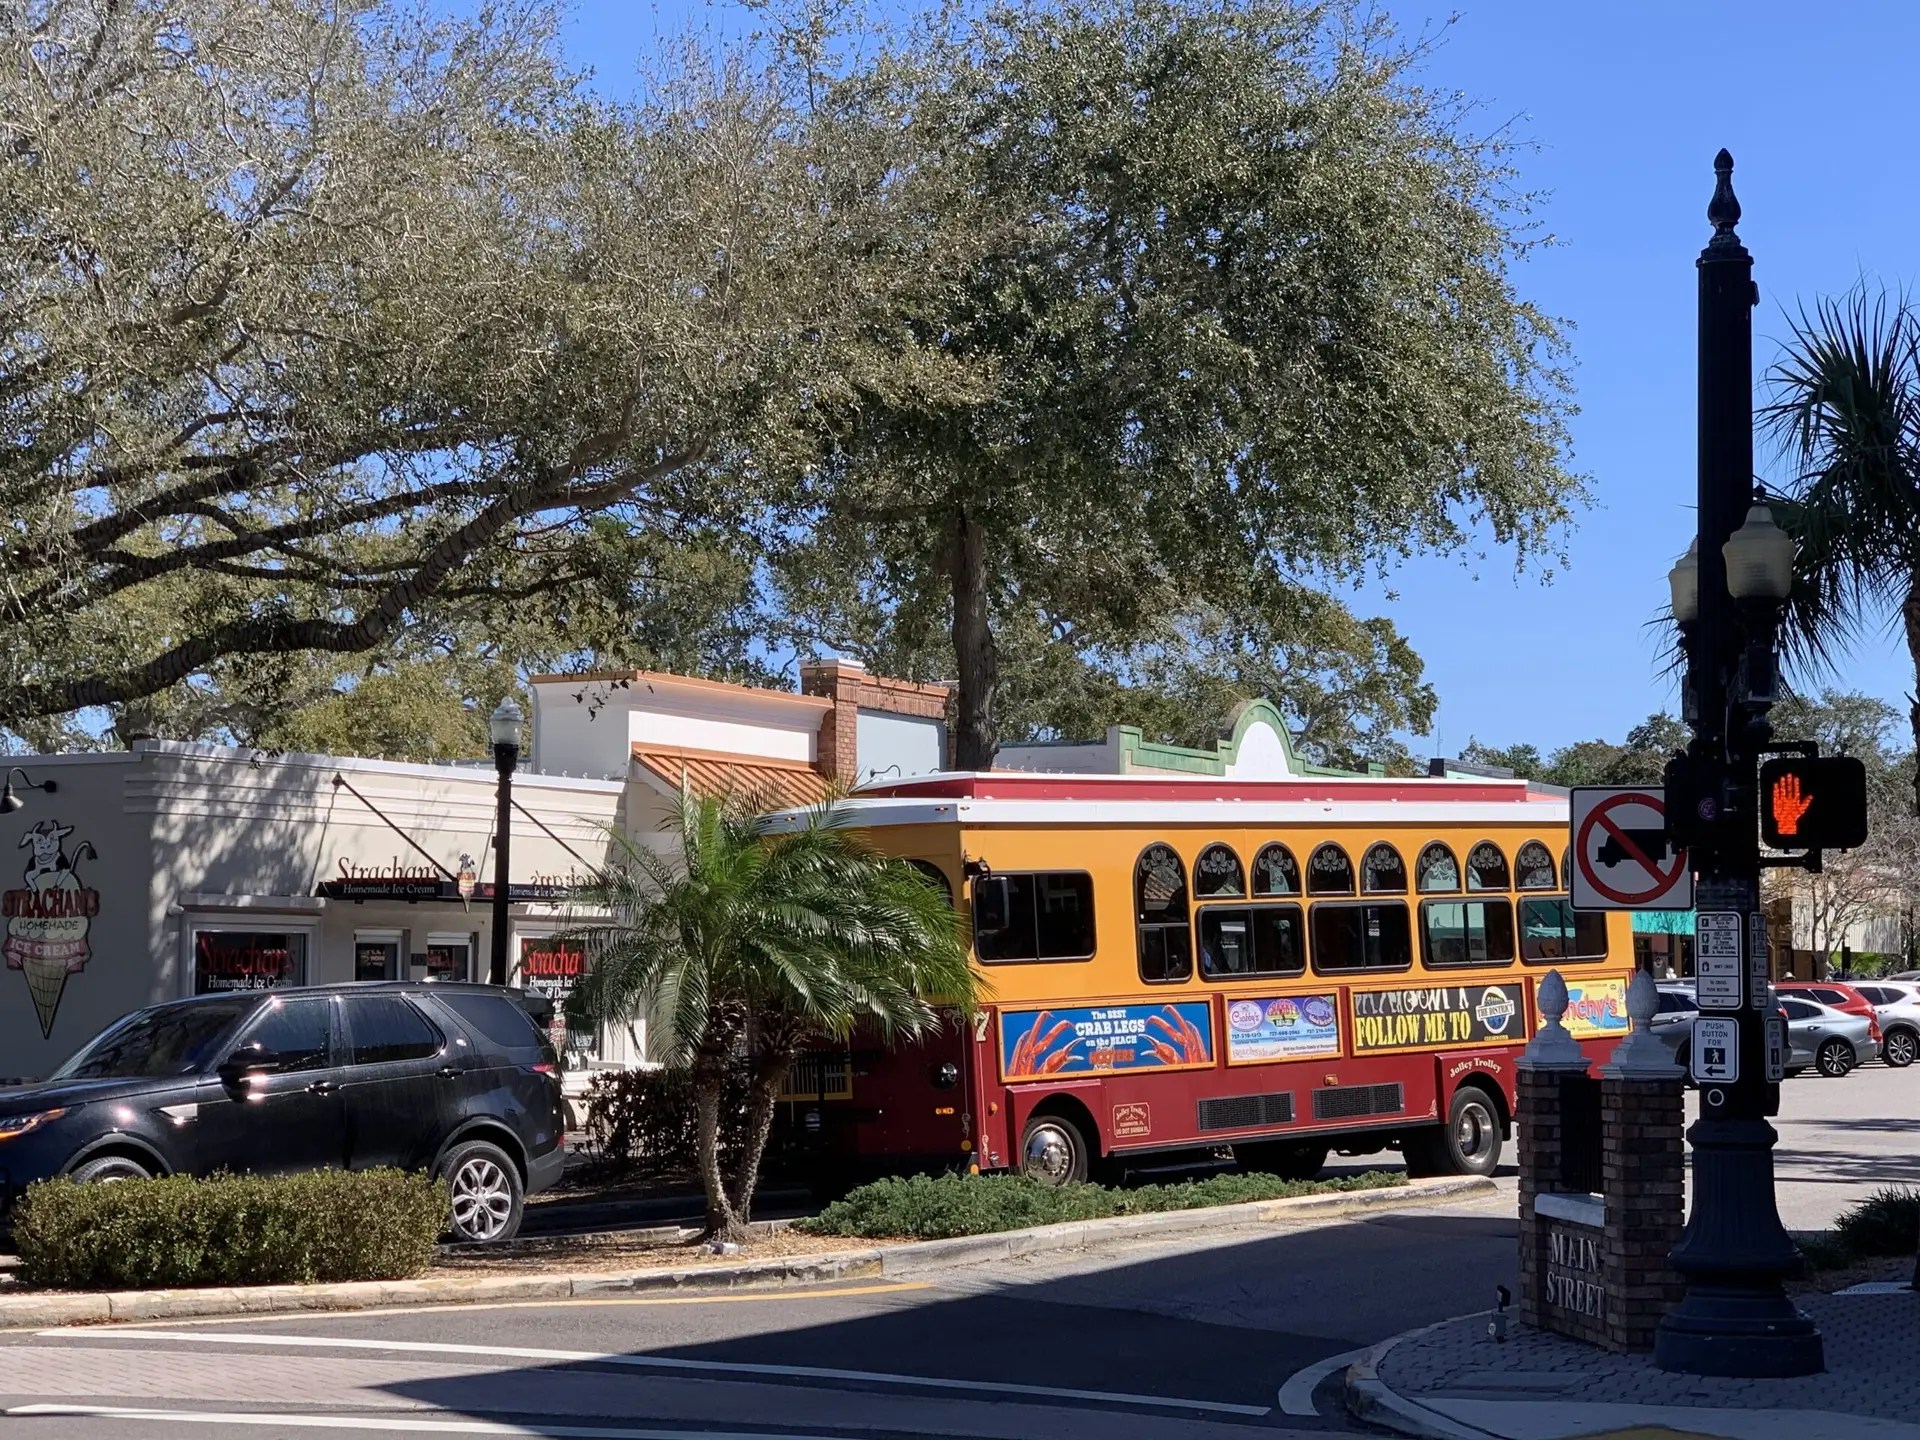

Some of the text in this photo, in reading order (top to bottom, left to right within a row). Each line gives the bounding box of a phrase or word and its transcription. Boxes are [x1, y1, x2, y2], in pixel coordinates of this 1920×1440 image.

[336, 856, 440, 884] Strachan's
[343, 884, 435, 894] Homemade Ice Cream
[2, 887, 100, 918] STRACHAN'S
[20, 920, 79, 931] HOMEMADE
[10, 939, 81, 957] ICE CREAM
[208, 975, 252, 989] Homemade
[254, 976, 265, 989] Ice
[530, 976, 563, 987] Homemade
[564, 976, 573, 987] Ice
[1091, 1009, 1127, 1020] The BEST
[1478, 1003, 1514, 1018] THE DISTRICT
[973, 1011, 990, 1042] 7
[1075, 1019, 1146, 1036] CRAB LEGS
[1356, 1011, 1472, 1047] FOLLOW ME TO
[1701, 1030, 1728, 1038] BUTTON
[1085, 1035, 1137, 1047] on the BEACH
[1089, 1049, 1134, 1065] HOOTERS
[1450, 1057, 1502, 1078] Jolley Trolley
[1551, 1232, 1598, 1272] MAIN
[1546, 1271, 1605, 1319] STREET
